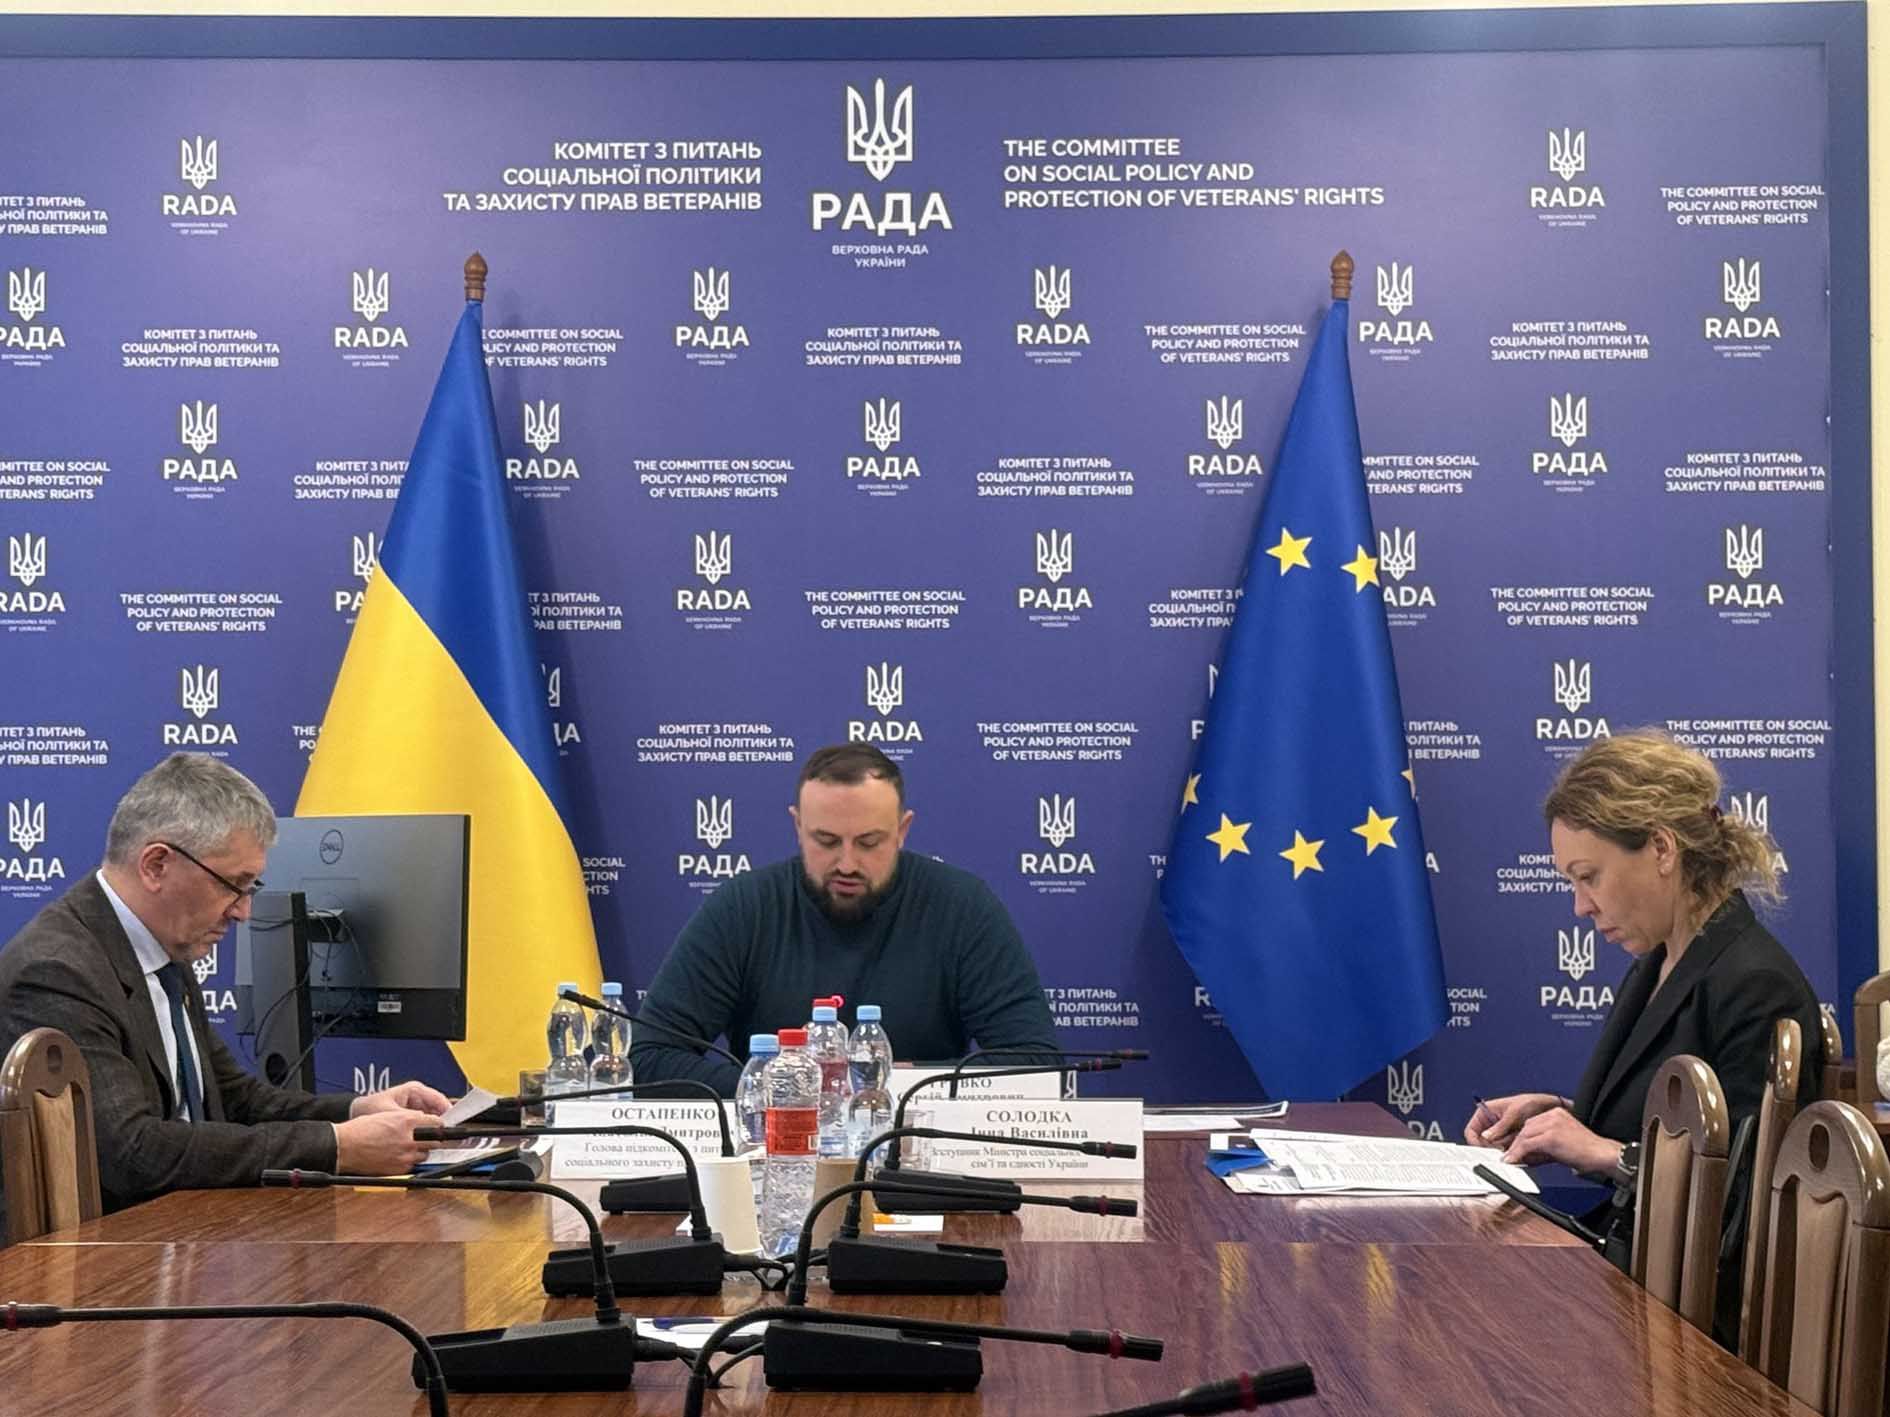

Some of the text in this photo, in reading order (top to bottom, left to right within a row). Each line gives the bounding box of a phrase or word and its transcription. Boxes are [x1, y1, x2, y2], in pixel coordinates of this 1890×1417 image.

[555, 142, 761, 160] КОМІТЕТ З ПИТАНЬ
[1004, 138, 1180, 156] THE COMMITTEE
[503, 165, 760, 188] СОЦІАЛЬНОЇ ПОЛІТИКИ
[1004, 163, 1254, 182] ON SOCIAL POLICY AND
[1005, 190, 1142, 208] PROTECTION
[1147, 189, 1176, 206] OF
[1304, 187, 1384, 205] RIGHTS
[1531, 186, 1605, 208] RADA
[1660, 185, 1824, 198] THE COMMITTEE ON SOCIAL
[163, 195, 237, 215] RADA
[443, 192, 762, 211] ТА ЗАХИСТУ ПРАВ ВЕТЕРАНІВ
[1667, 199, 1817, 211] POLICY AND PROTECTION
[813, 192, 952, 236] РАДА
[1677, 215, 1693, 225] OF
[1764, 213, 1808, 224] RIGHTS
[832, 244, 928, 255] ВЕРХОВНА РАДА
[855, 256, 906, 267] УКРАЇНИ
[827, 327, 879, 338] КОМІТЕТ
[891, 327, 940, 337] ПИТАНЬ
[1359, 321, 1433, 345] РАДА
[1512, 322, 1565, 332] КОМІТЕТ
[1577, 321, 1627, 332] ПИТАНЬ
[1705, 317, 1780, 338] RADA
[144, 329, 196, 340] КОМІТЕТ
[208, 329, 258, 340] ПИТАНЬ
[335, 327, 408, 347] RADA
[676, 326, 749, 349] РАДА
[1017, 324, 1090, 344] RADA
[1490, 334, 1650, 347] СОЦІАЛЬНОЇ ПОЛІТИКИ ТА
[122, 341, 280, 354] СОЦІАЛЬНОЇ ПОЛІТИКИ ТА
[805, 340, 962, 352] СОЦІАЛЬНОЇ ПОЛІТИКИ ТА
[123, 356, 279, 367] ЗАХИСТУ ПРАВ ВЕТЕРАНІВ
[806, 354, 961, 365] ЗАХИСТУ ПРАВ ВЕТЕРАНІВ
[633, 460, 794, 470] THE COMMITTEE ON SOCIAL
[1189, 455, 1262, 475] RADA
[1533, 452, 1607, 476] РАДА
[1687, 453, 1740, 464] КОМІТЕТ
[1752, 453, 1802, 463] ПИТАНЬ
[164, 459, 238, 483] РАДА
[316, 461, 369, 472] КОМІТЕТ
[507, 458, 580, 479] RADA
[847, 457, 920, 480] РАДА
[1664, 465, 1825, 478] СОЦІАЛЬНОЇ ПОЛІТИКИ ТА
[27, 475, 103, 486] PROTECTION
[294, 472, 369, 486] СОЦІАЛЬНОЇ
[640, 473, 787, 484] POLICY AND PROTECTION
[1666, 480, 1824, 491] ЗАХИСТУ ПРАВ ВЕТЕРАНІВ
[50, 489, 94, 499] RIGHTS
[295, 488, 383, 499] ЗАХИСТУ ПРАВ
[649, 487, 666, 498] OF
[734, 487, 778, 497] RIGHTS
[120, 593, 282, 604] THE COMMITTEE ON SOCIAL
[678, 590, 751, 610] RADA
[1019, 588, 1092, 611] РАДА
[1382, 586, 1436, 606] ADA
[1708, 584, 1784, 608] РАДА
[127, 607, 275, 618] POLICY AND PROTECTION
[136, 621, 153, 631] OF
[222, 621, 266, 631] RIGHTS
[849, 721, 922, 741] RADA
[977, 722, 1138, 733] THE COMMITTEE ON SOCIAL
[1408, 721, 1458, 732] ПИТАНЬ
[1536, 718, 1610, 739] RADA
[164, 724, 238, 744] RADA
[1405, 735, 1482, 745] ОЛІТИКИ ТА
[984, 736, 1131, 746] POLICY AND PROTECTION
[993, 750, 1009, 760] OF
[1078, 750, 1122, 760] RIGHTS
[1414, 748, 1480, 759] ВЕТЕРАНІВ
[583, 857, 626, 867] SOCIAL
[679, 855, 751, 878] РАДА
[1021, 853, 1095, 874] RADA
[1541, 986, 1614, 1010] РАДА
[611, 1107, 716, 1120] ОСТАПЕНКО
[986, 1110, 1072, 1123] СОЛОДКА
